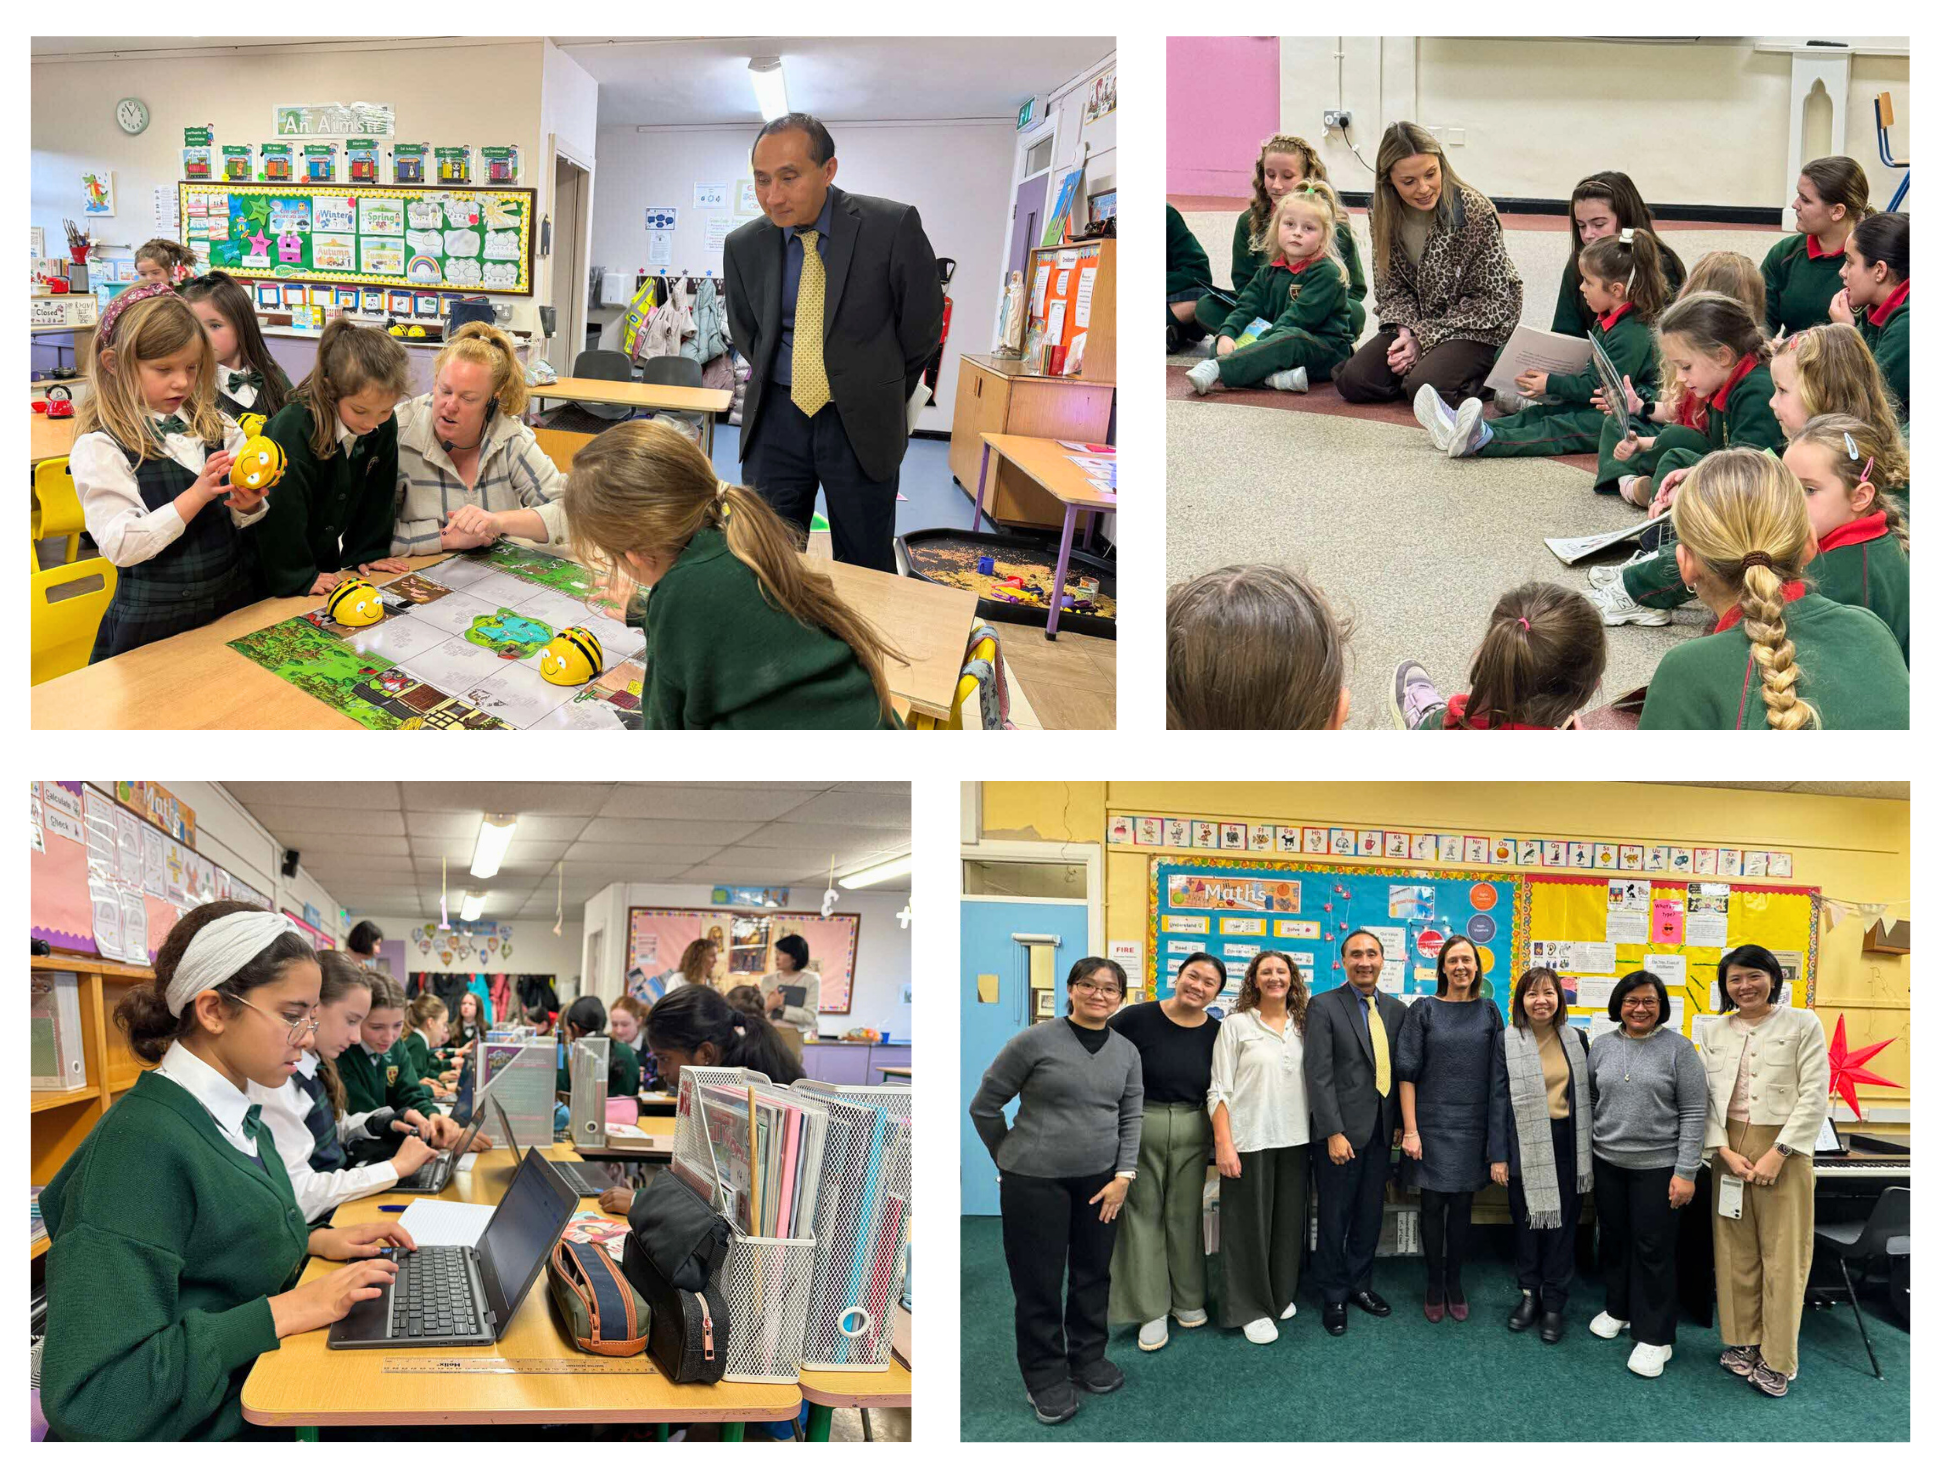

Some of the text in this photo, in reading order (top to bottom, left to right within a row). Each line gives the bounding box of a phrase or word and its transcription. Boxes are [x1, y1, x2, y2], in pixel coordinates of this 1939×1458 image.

[284, 115, 310, 134] An
[320, 210, 349, 219] Winter
[367, 212, 395, 224] Spring
[318, 247, 350, 256] Autumn
[36, 308, 58, 316] Closed
[46, 788, 72, 810] Calculate
[50, 816, 70, 830] Check
[1204, 883, 1267, 901] Maths
